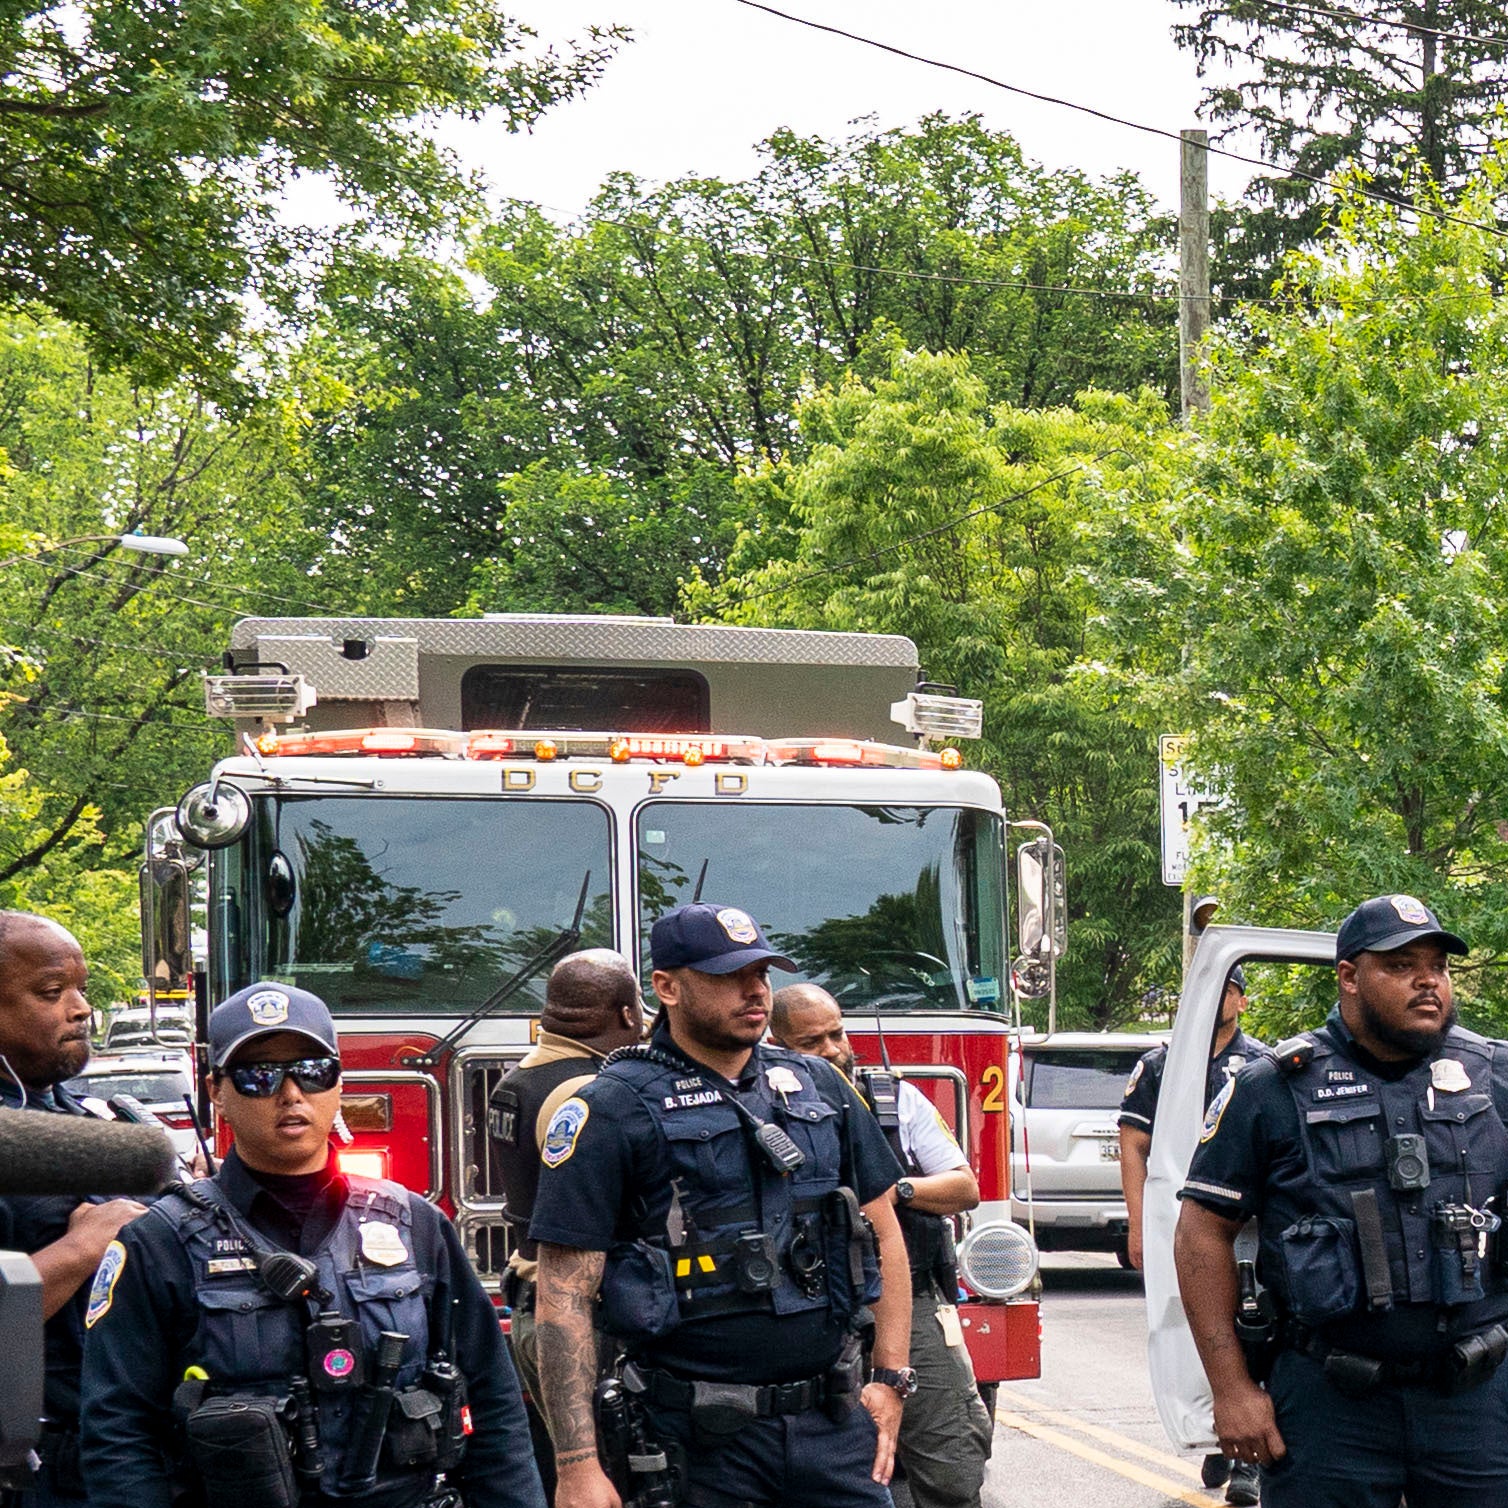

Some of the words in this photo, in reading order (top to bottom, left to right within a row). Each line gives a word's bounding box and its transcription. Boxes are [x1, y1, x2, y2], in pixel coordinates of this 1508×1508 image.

[675, 1076, 702, 1091] POLICE
[1328, 1071, 1354, 1081] POLICE
[980, 1065, 1004, 1113] 2
[664, 1096, 678, 1109] B.
[678, 1090, 723, 1106] TEJADA
